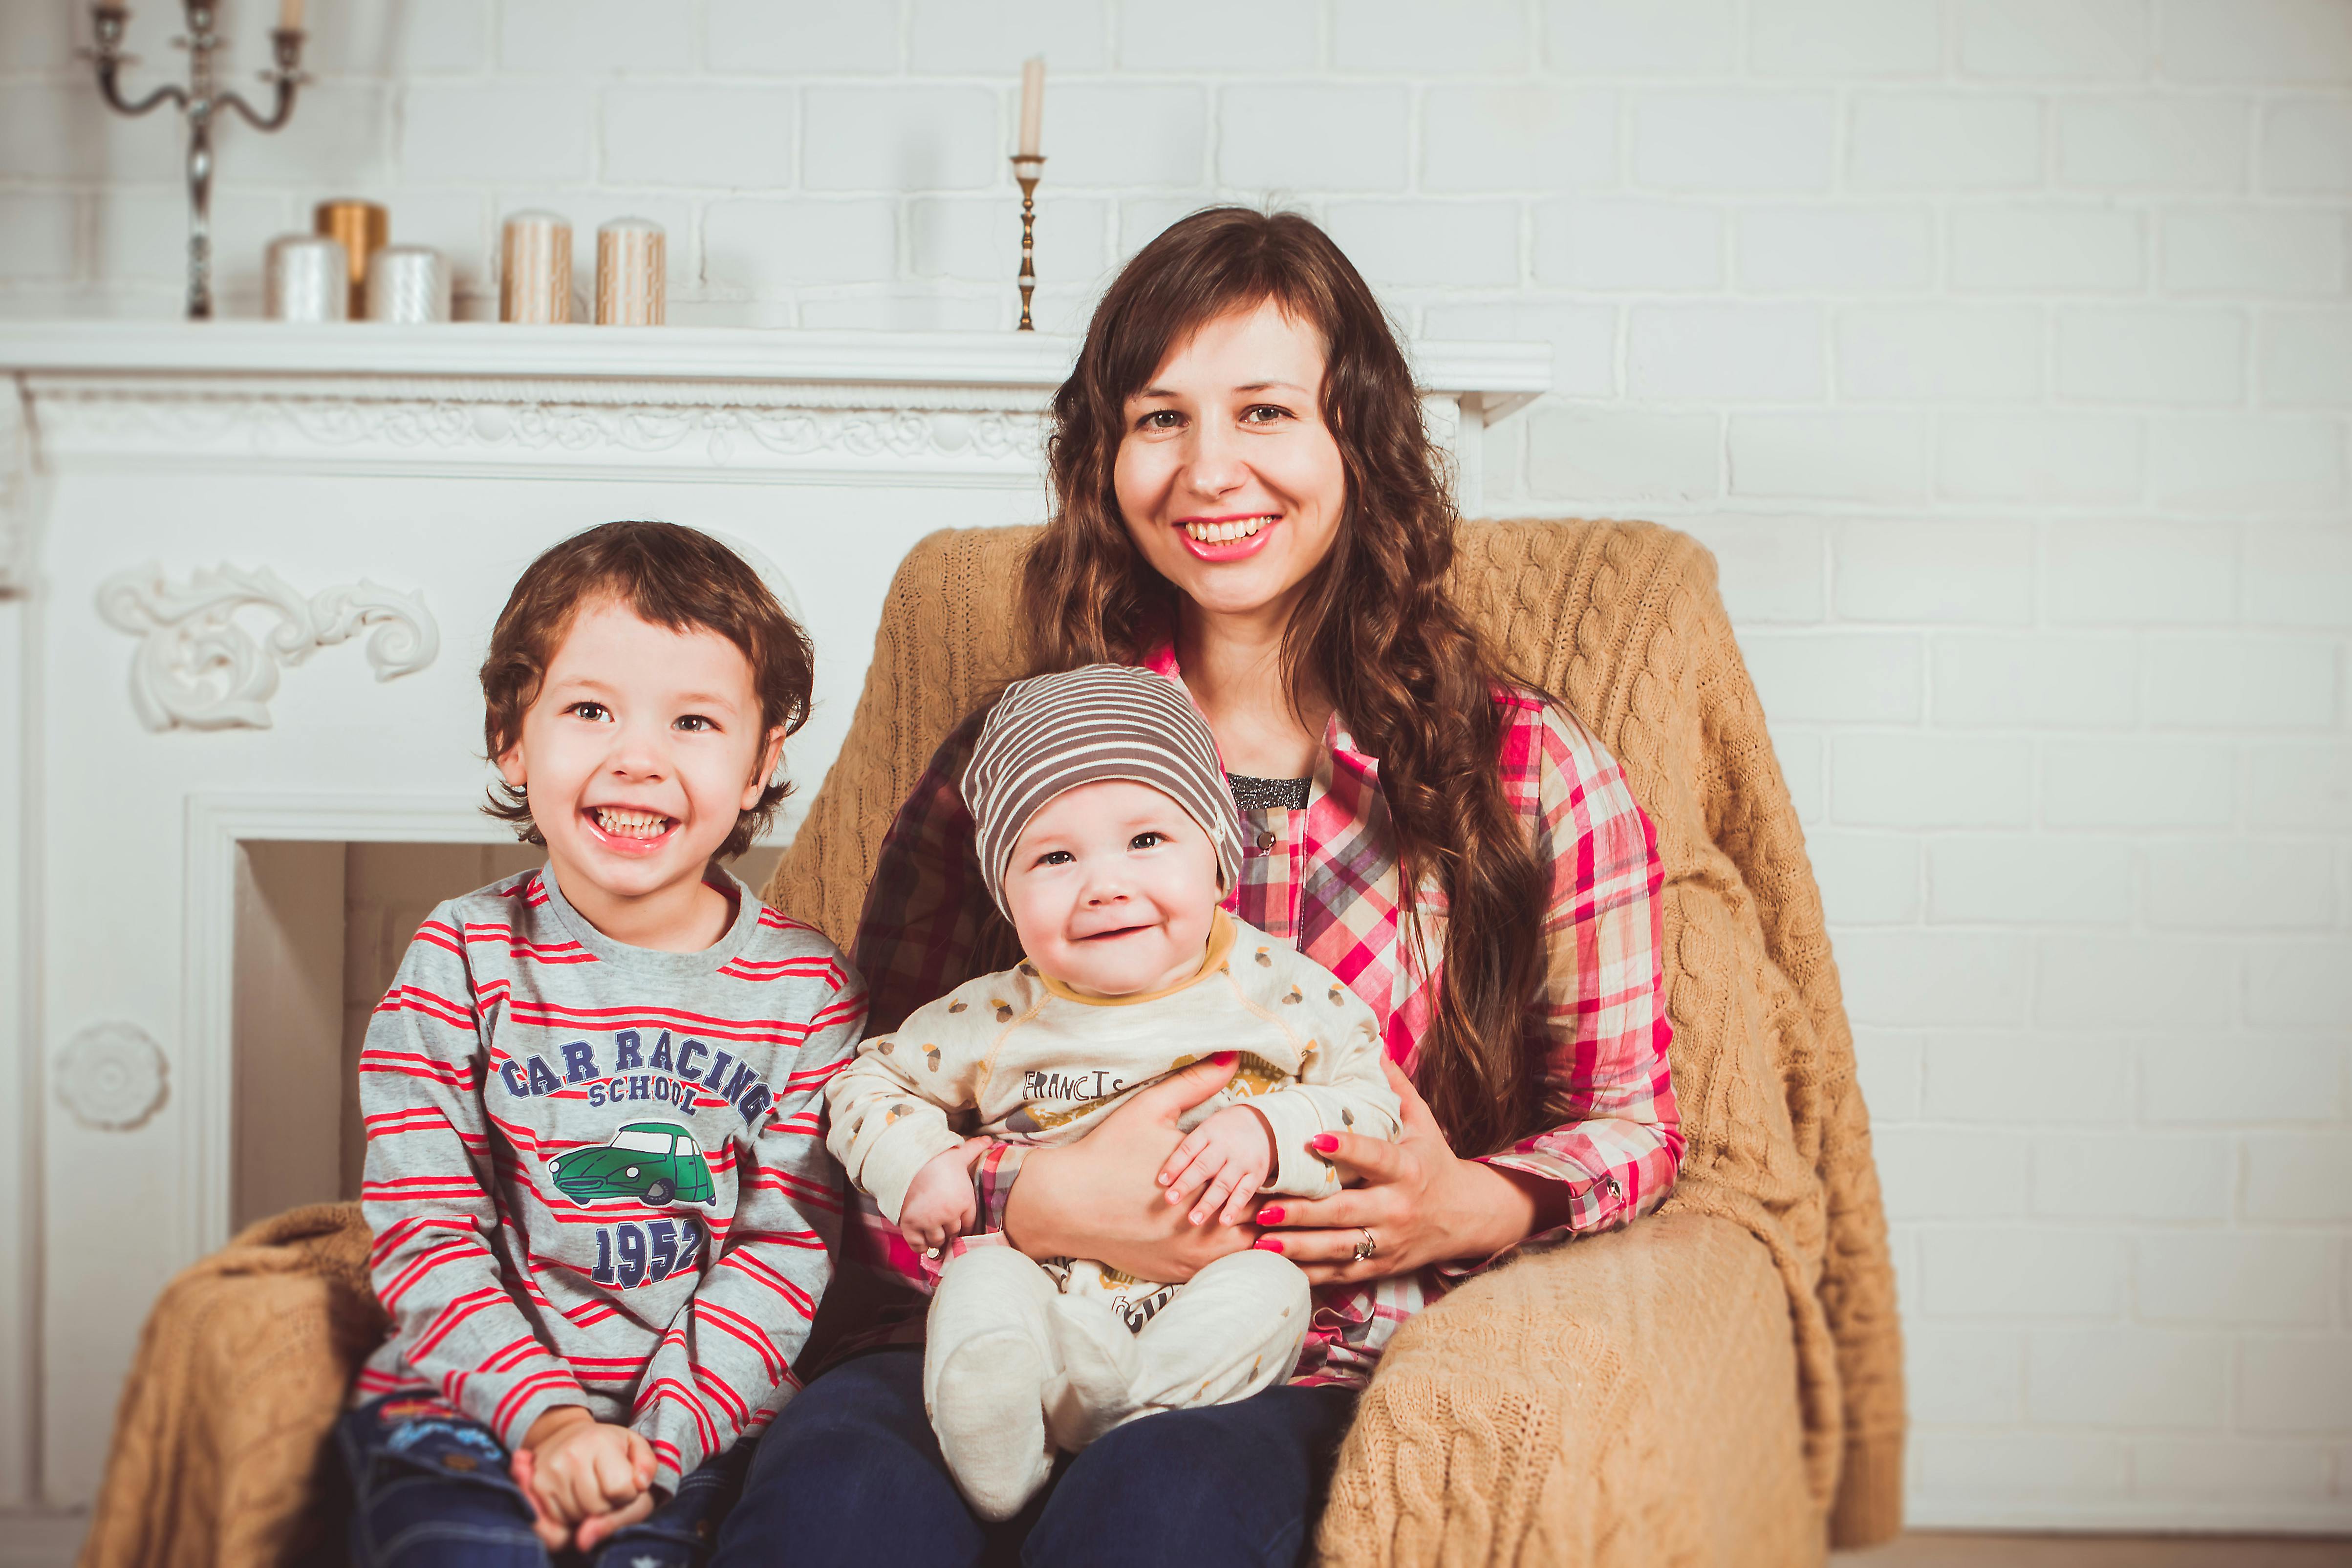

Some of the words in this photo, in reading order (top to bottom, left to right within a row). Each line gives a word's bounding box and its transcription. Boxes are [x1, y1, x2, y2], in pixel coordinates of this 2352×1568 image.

[498, 1039, 601, 1099] CAR
[614, 1027, 774, 1127] RACING
[588, 1074, 699, 1117] SCHOOL
[591, 1217, 705, 1290] 1952
